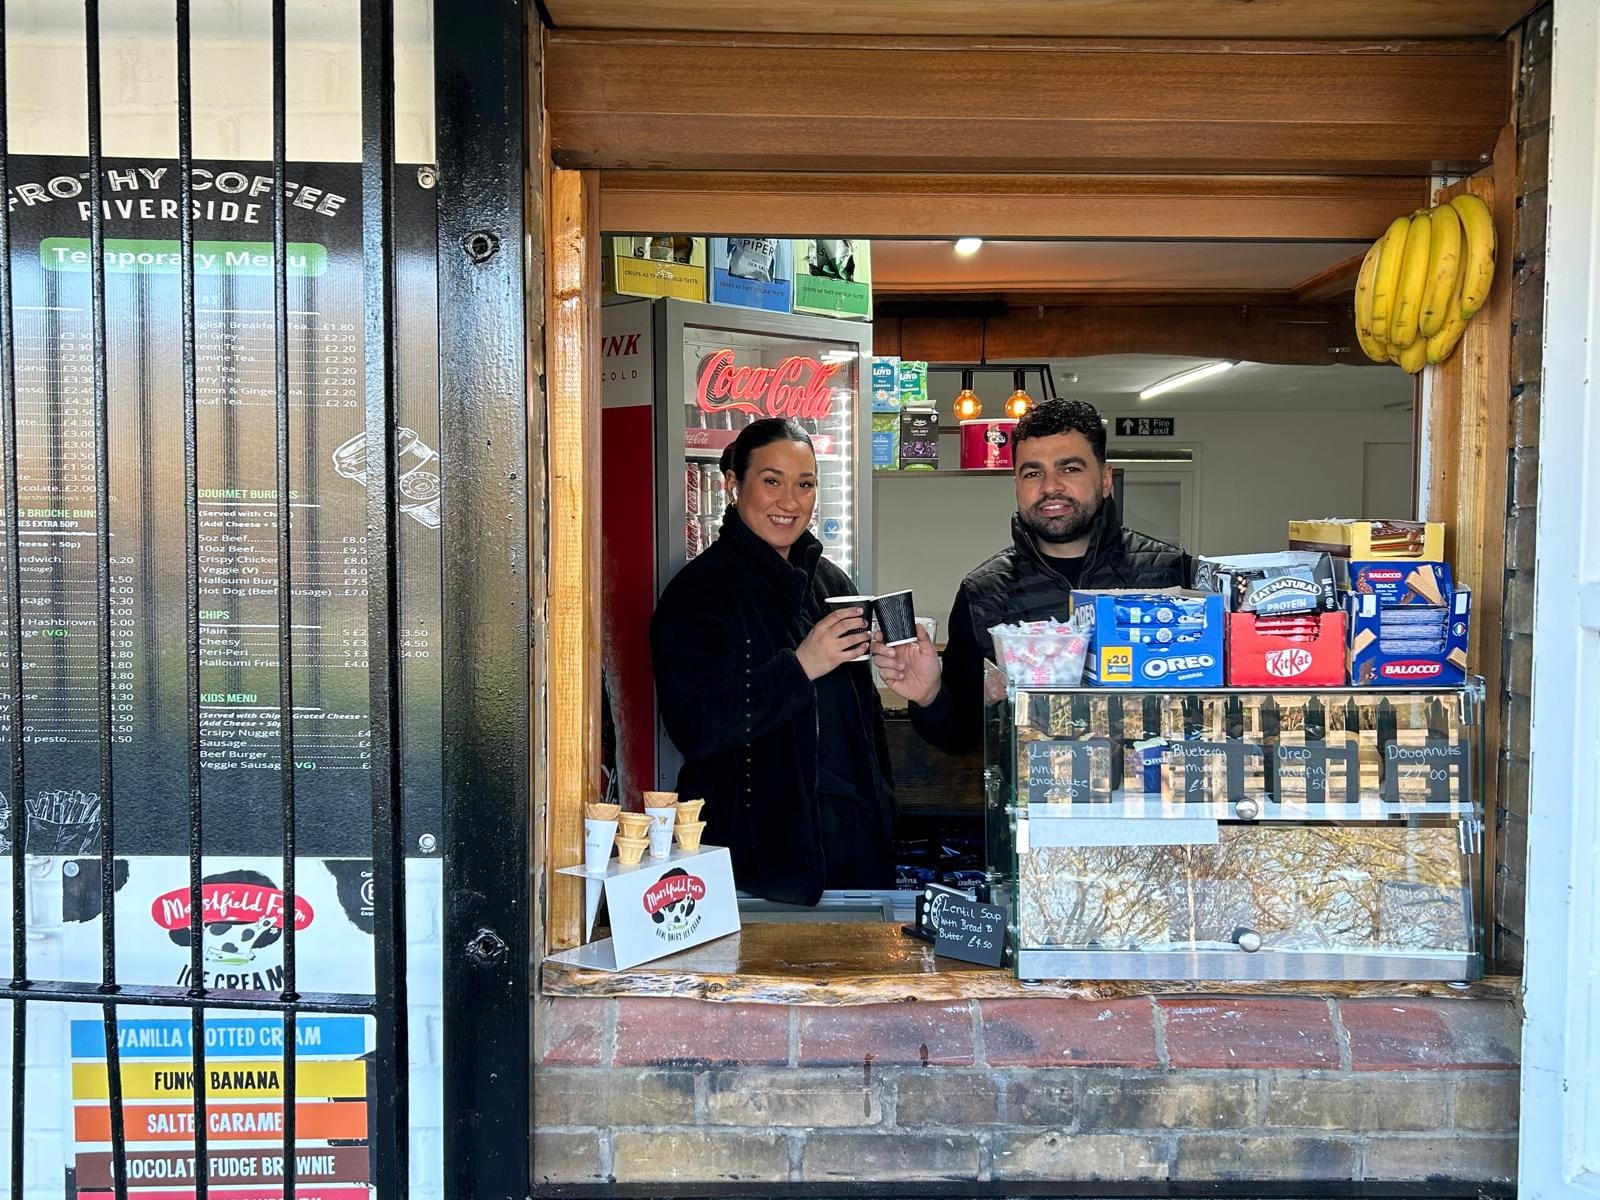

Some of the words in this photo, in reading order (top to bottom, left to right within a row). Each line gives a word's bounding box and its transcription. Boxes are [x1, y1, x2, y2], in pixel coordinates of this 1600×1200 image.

[324, 334, 356, 342] £2.20
[325, 345, 356, 353] £2.20
[325, 356, 356, 364] £2.20
[326, 367, 357, 375] £2.20
[324, 378, 356, 386] £2.20
[697, 349, 841, 418] Coca-Cola
[241, 387, 277, 397] Ginge
[325, 389, 357, 397] £2.20
[326, 400, 357, 408] £2.20
[198, 489, 248, 499] GOURMET
[250, 490, 299, 500] BURGS
[27, 509, 73, 518] BRIOCHE
[199, 510, 236, 518] (Served
[238, 510, 261, 518] with
[32, 520, 58, 528] EXTRA
[225, 521, 261, 529] Cheese
[221, 534, 248, 542] Beef
[228, 545, 255, 553] Beef
[198, 556, 238, 565] Crispy
[201, 567, 239, 576] Veggie
[242, 566, 259, 575] (V)
[198, 577, 250, 585] Halloumi
[253, 577, 279, 587] Burg
[198, 587, 221, 595] Hot
[222, 587, 246, 597] Dog
[1253, 588, 1272, 602] EAT
[1273, 579, 1318, 594] NATURAL
[1267, 599, 1307, 611] PROTEIN
[199, 610, 230, 620] CHIPS
[28, 618, 97, 626] Hashbrown
[41, 629, 68, 638] (VG)
[199, 627, 228, 635] Plain
[199, 638, 241, 648] Cheesy
[199, 648, 249, 657] Peri-Peri
[199, 659, 251, 667] Halloumi
[1144, 655, 1214, 678] OREO
[1272, 649, 1310, 676] KitKat
[1385, 664, 1441, 674] BALOCCO
[200, 693, 226, 703] KIDS
[227, 693, 258, 703] MENU
[199, 712, 237, 720] (Served
[238, 712, 257, 720] with
[259, 712, 281, 721] Chip
[199, 729, 236, 739] Crsipy
[238, 729, 280, 739] Nugget
[34, 735, 67, 744] pesto
[199, 739, 247, 749] Sausage
[199, 750, 227, 759] Beef
[229, 751, 267, 761] Burger
[1277, 744, 1312, 760] Oreo
[200, 761, 238, 770] Veggie
[240, 761, 282, 771] Sausag
[295, 762, 316, 771] VG)
[162, 890, 263, 926] Mashfield
[942, 898, 975, 919] Lentil
[980, 908, 1002, 924] Soup
[960, 918, 982, 933] Bread
[938, 928, 964, 941] Butter
[967, 935, 993, 949] £4.50
[118, 1027, 183, 1048] VANILLA
[260, 1026, 322, 1046] CRAM
[154, 1071, 195, 1090] FUNK
[210, 1070, 280, 1090] BANANA
[147, 1113, 195, 1134] SALTE
[209, 1112, 282, 1132] CARAME
[209, 1157, 258, 1178] FUDGE
[262, 1155, 336, 1177] BRWNIE
